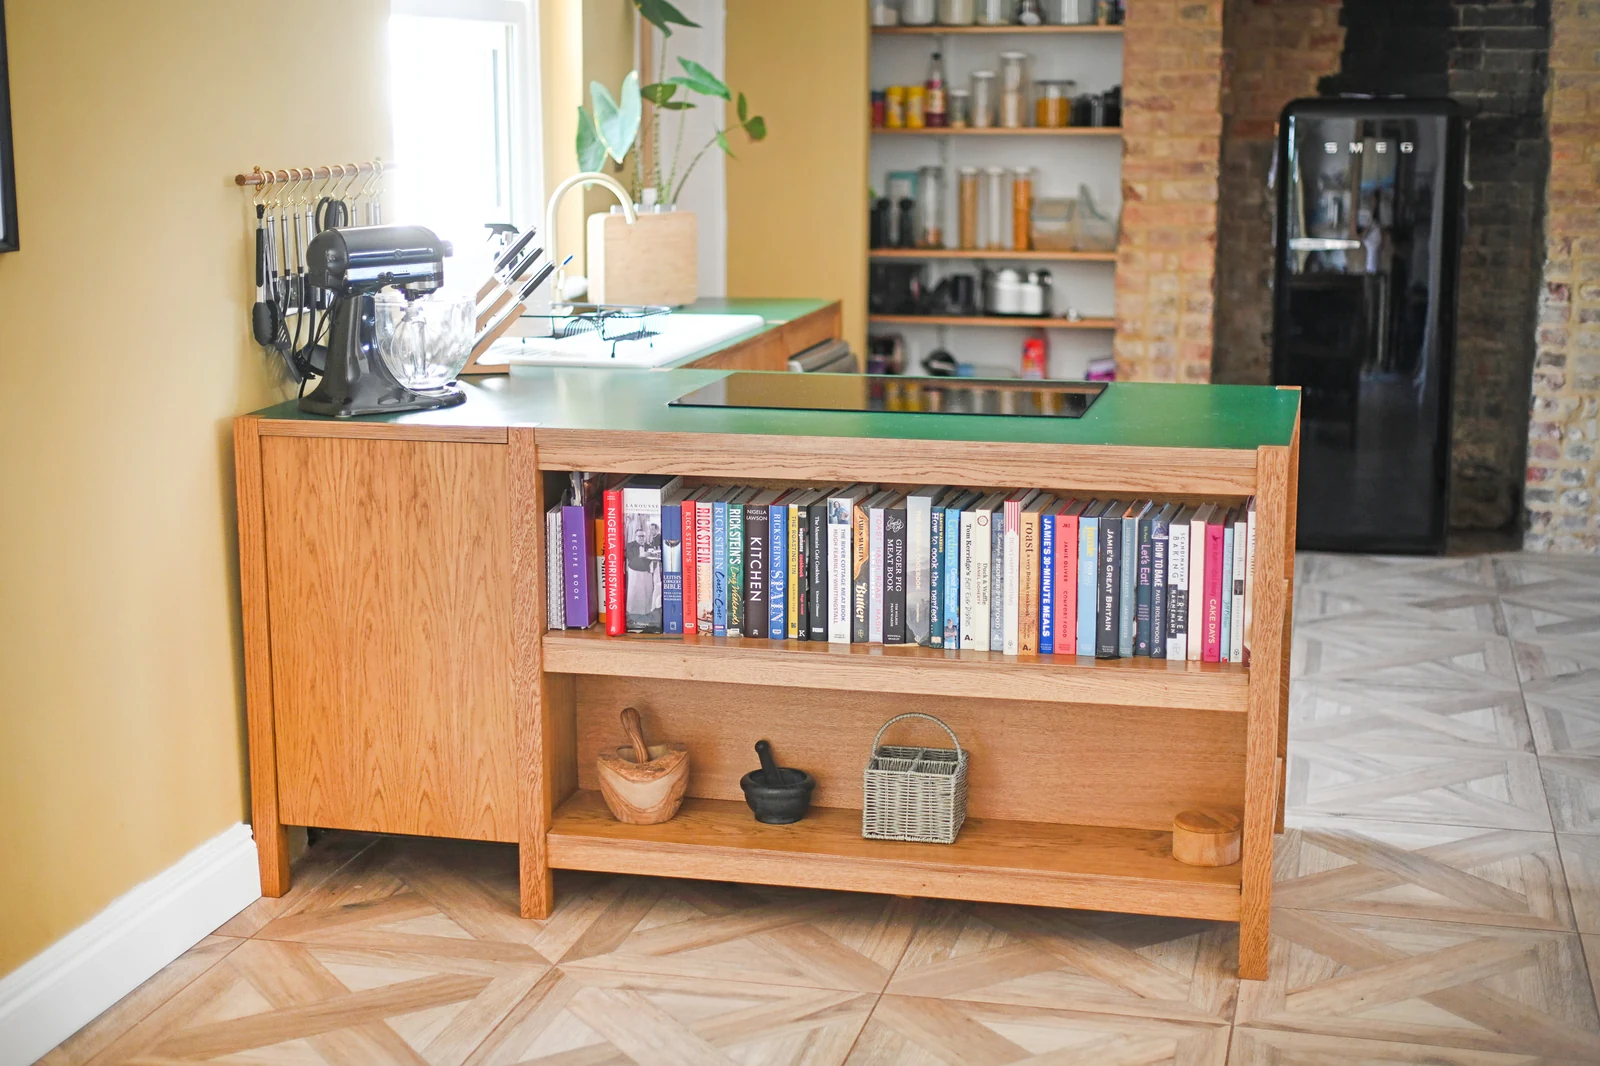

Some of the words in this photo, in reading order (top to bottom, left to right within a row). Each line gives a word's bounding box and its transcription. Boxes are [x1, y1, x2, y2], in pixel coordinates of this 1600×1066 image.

[1324, 141, 1414, 154] SMEG
[606, 508, 616, 550] NIGELLA
[697, 507, 711, 532] RICK
[715, 507, 724, 533] RICK
[729, 508, 741, 530] RICK
[773, 513, 781, 533] RICK
[931, 512, 939, 534] How
[697, 534, 711, 564] STEIN
[729, 531, 741, 565] STEIN'S
[773, 534, 781, 568] STEIN'S
[931, 536, 939, 546] to
[948, 519, 958, 567] Gordon's
[1025, 521, 1034, 553] roast
[1043, 518, 1052, 555] JAMIE'S
[1106, 528, 1114, 563] JAMIE'S
[1154, 541, 1164, 559] HOW
[715, 537, 724, 570] STEIN
[750, 537, 762, 602] KITCHEN
[931, 547, 939, 569] cook
[1140, 544, 1150, 565] Let's
[1154, 559, 1164, 569] TO
[1172, 536, 1180, 579] BAKING
[607, 553, 618, 611] CHRISTMAS
[931, 571, 939, 588] the
[950, 568, 958, 587] Great
[1043, 556, 1051, 604] 30-MINUTE
[1140, 567, 1150, 586] Eat!
[1154, 569, 1163, 587] BAKE
[731, 585, 742, 625] Weekends
[770, 569, 784, 624] SPAIN
[856, 582, 868, 623] Butter
[930, 590, 938, 623] perfect
[1208, 599, 1217, 621] CAKE
[1042, 605, 1051, 637] MEALS
[1105, 596, 1113, 631] BRITAIN
[1153, 606, 1161, 644] HOLLYWOOD
[1207, 623, 1216, 644] DAYS
